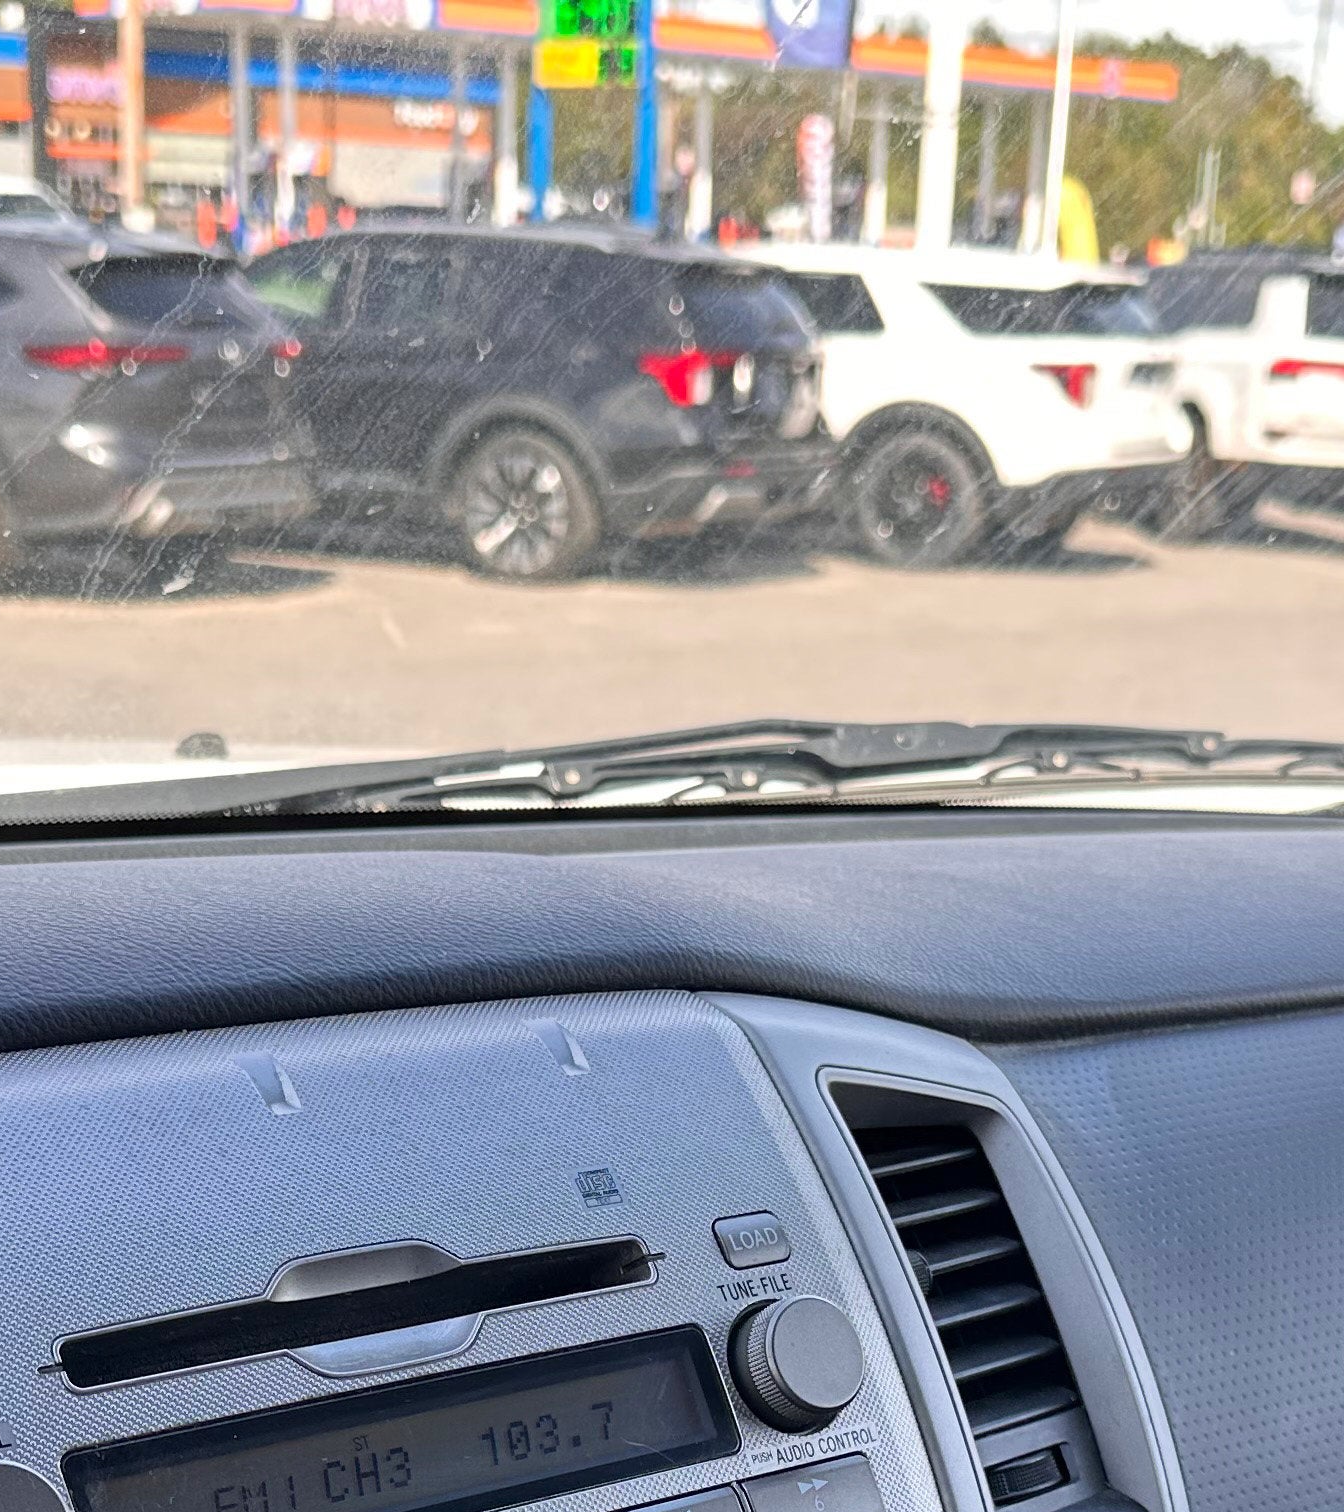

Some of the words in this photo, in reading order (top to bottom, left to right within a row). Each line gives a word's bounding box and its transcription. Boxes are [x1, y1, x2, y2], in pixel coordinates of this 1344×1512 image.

[728, 1227, 779, 1251] LOAD
[323, 1446, 412, 1504] CH3
[481, 1402, 613, 1466] 103.7
[751, 1451, 773, 1465] PUSH
[776, 1442, 815, 1465] AUDIO
[817, 1428, 877, 1455] CONTROL
[814, 1495, 825, 1511] 6
